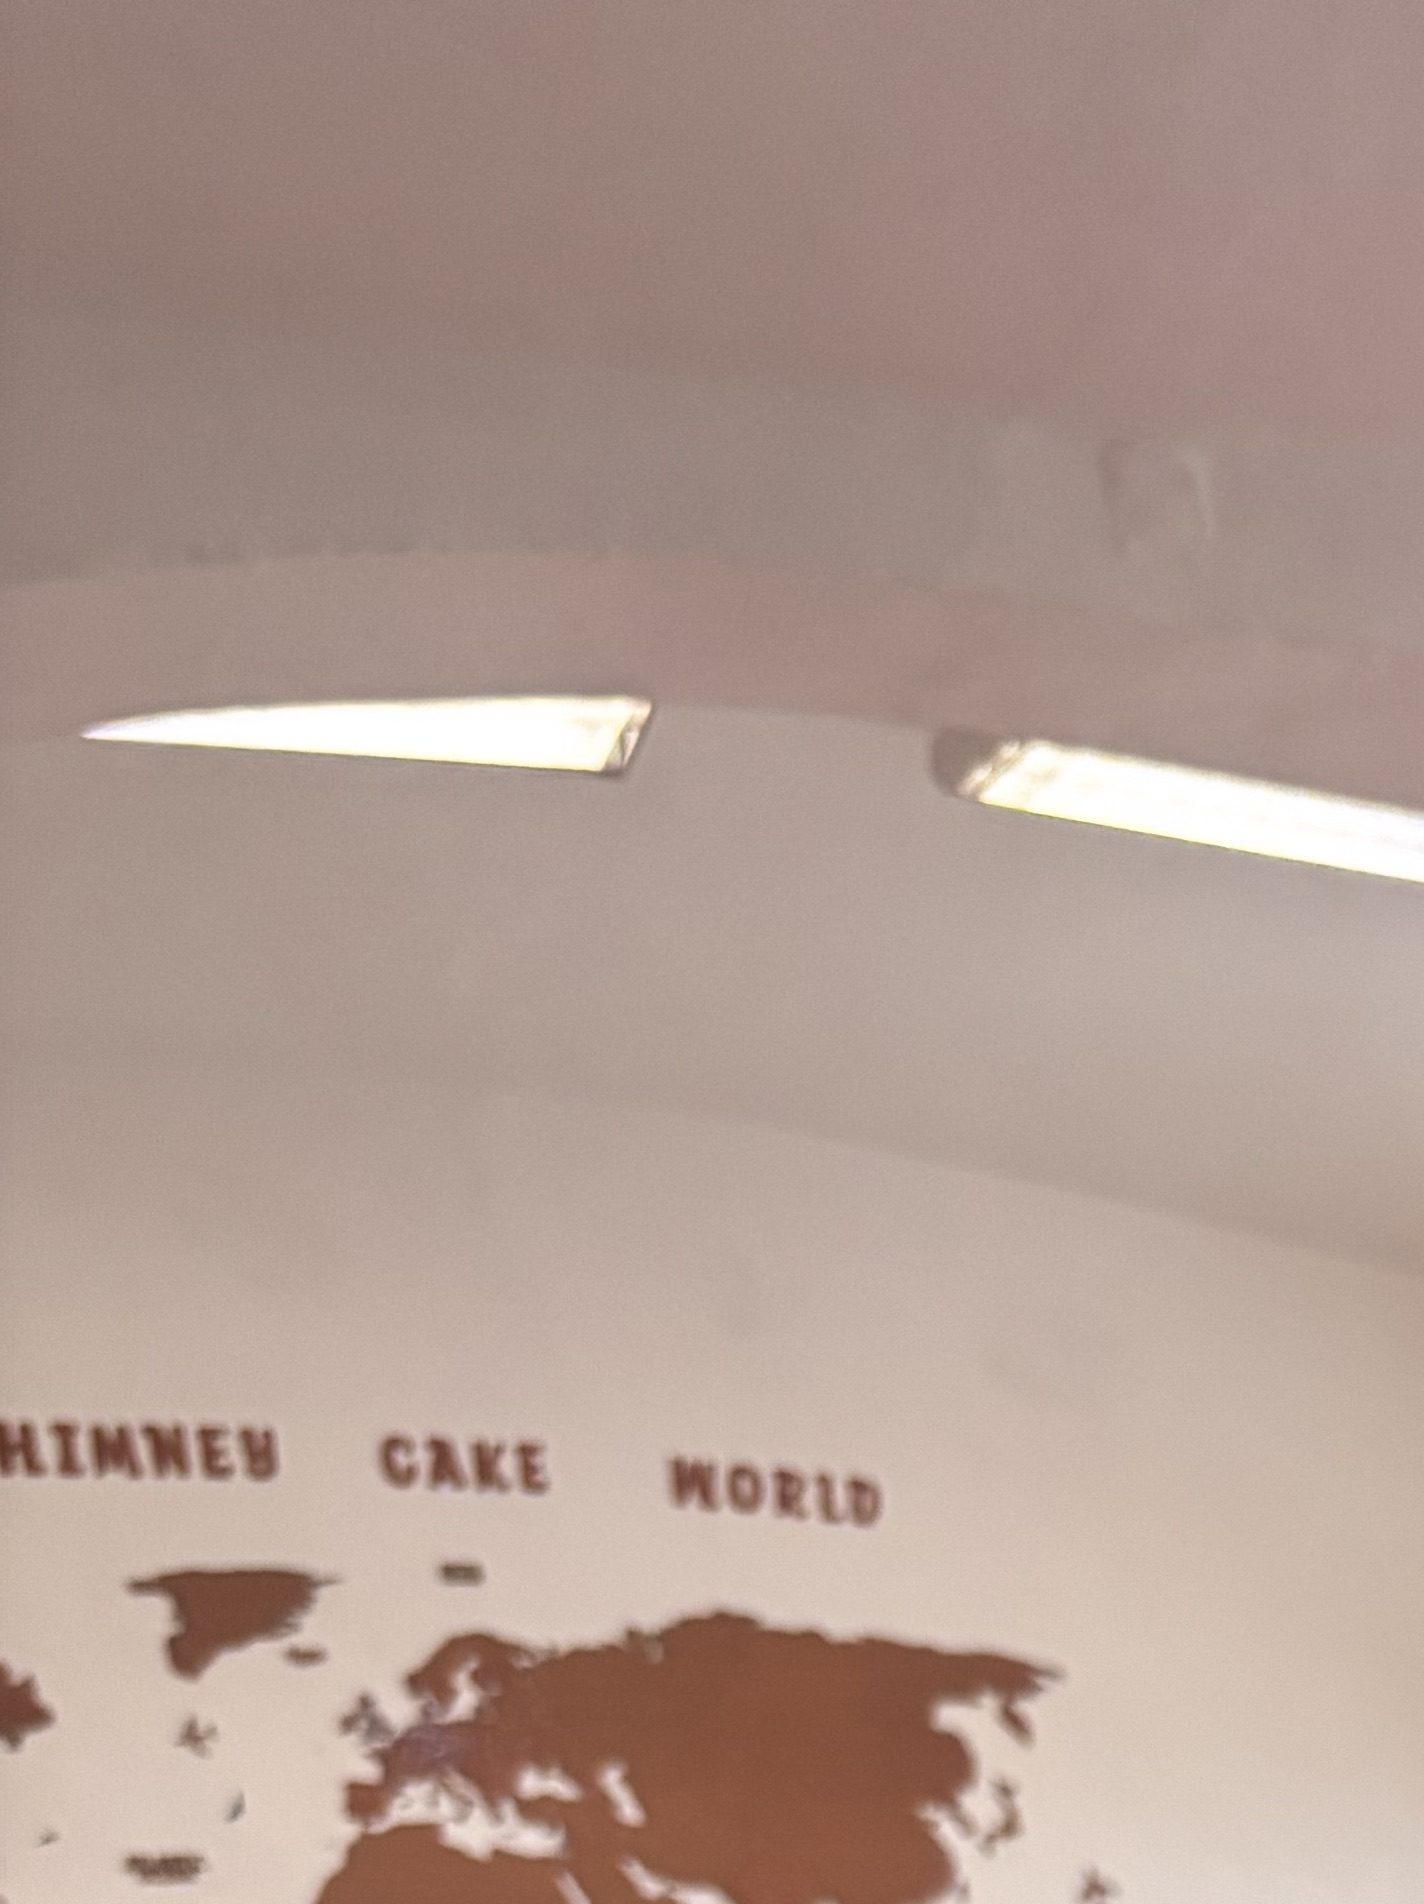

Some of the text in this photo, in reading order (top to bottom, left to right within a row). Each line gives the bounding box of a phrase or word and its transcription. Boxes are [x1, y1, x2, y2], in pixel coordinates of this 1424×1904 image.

[0, 1419, 882, 1527] HIMNEY CAKE WORLD
